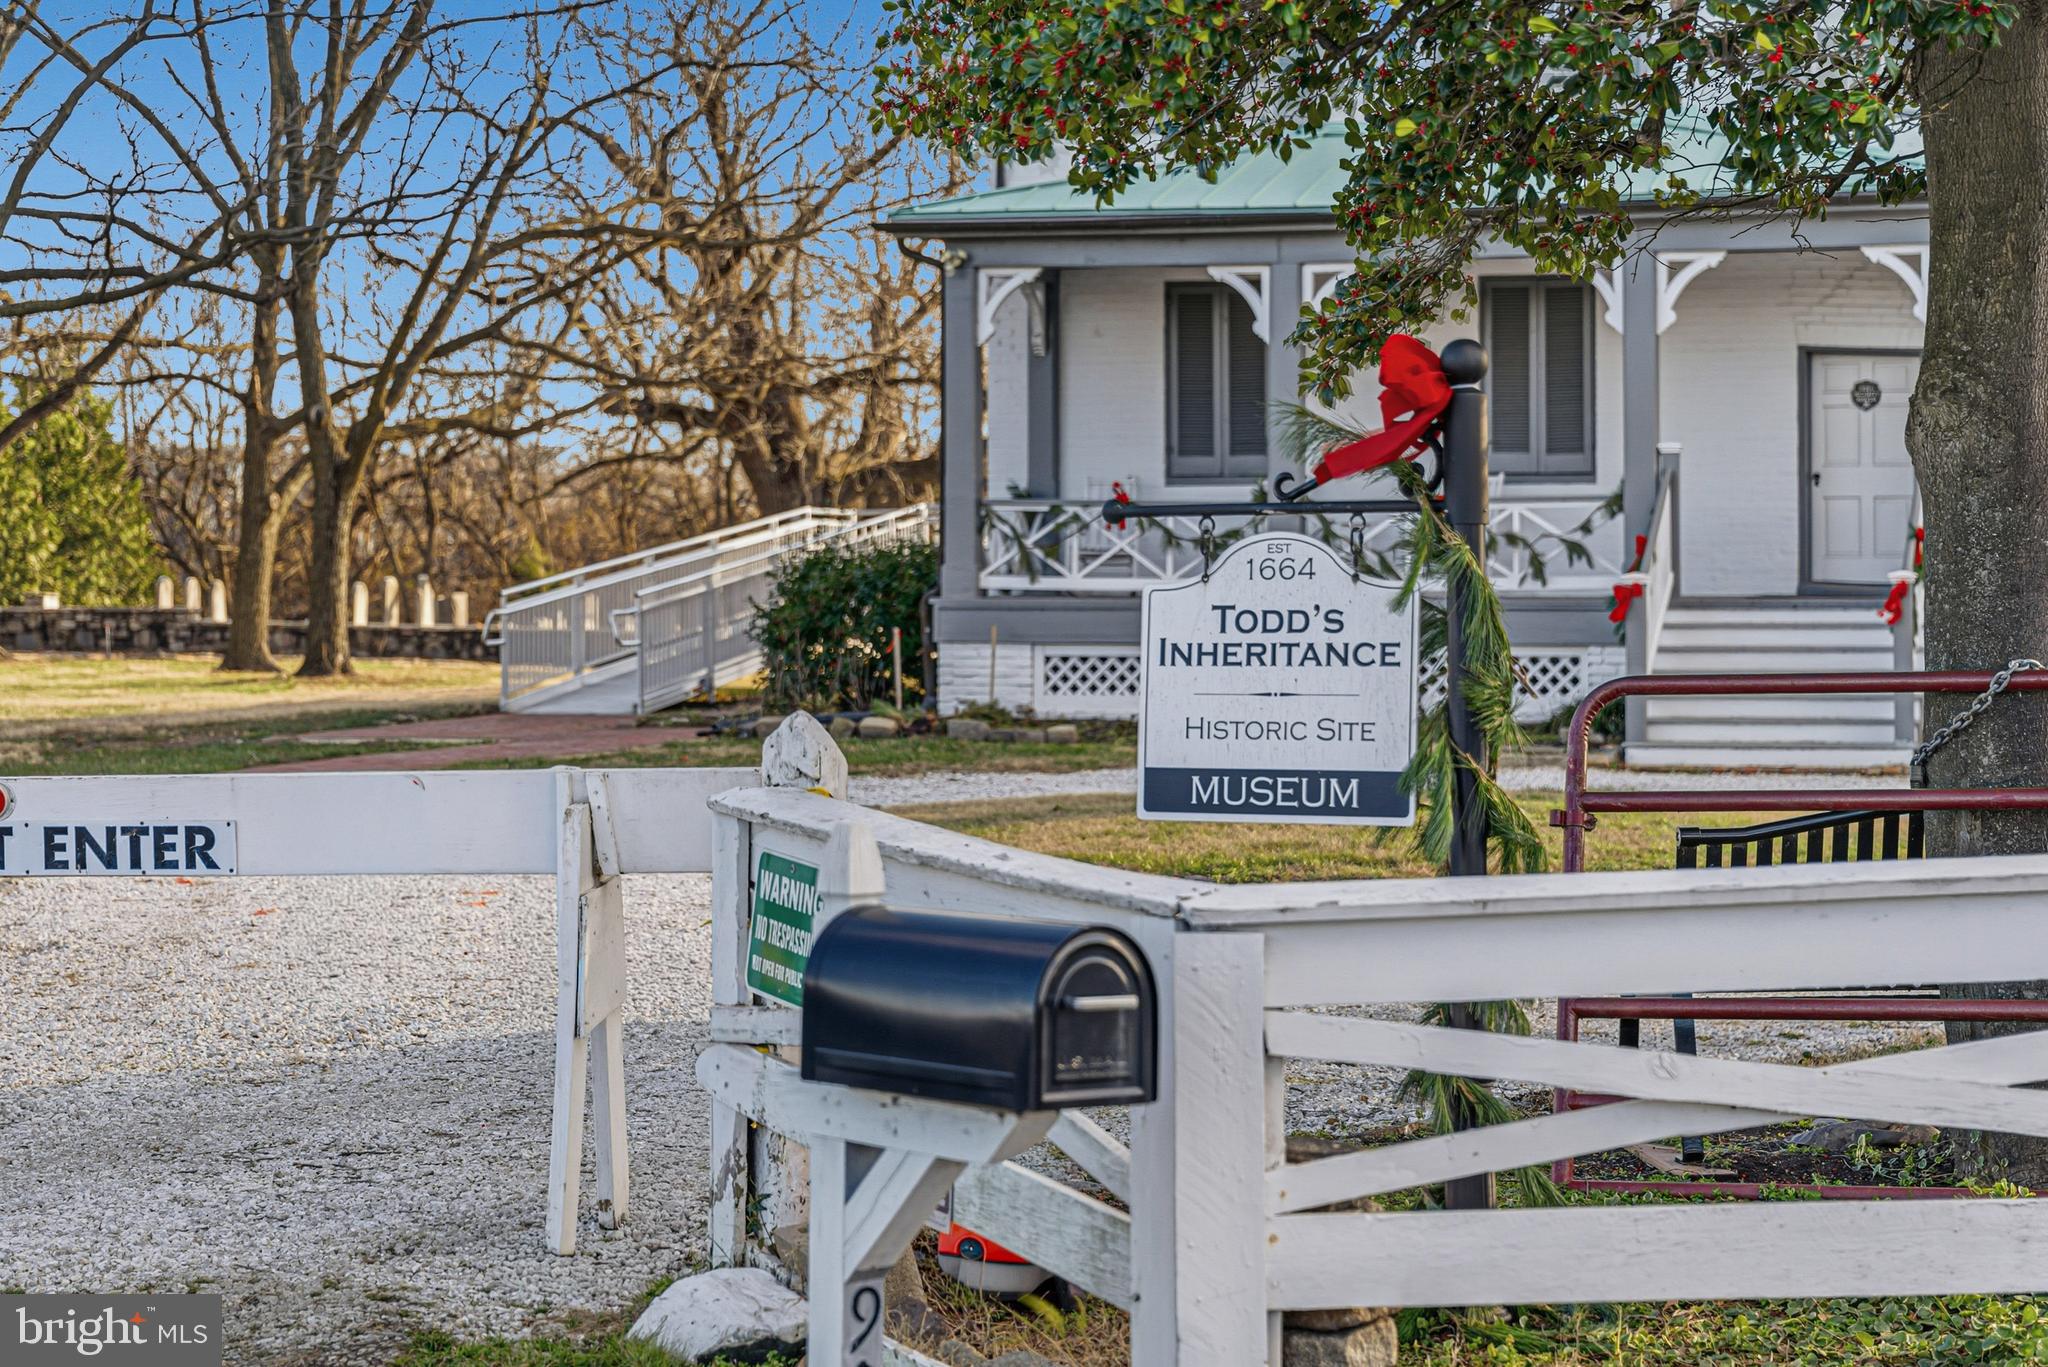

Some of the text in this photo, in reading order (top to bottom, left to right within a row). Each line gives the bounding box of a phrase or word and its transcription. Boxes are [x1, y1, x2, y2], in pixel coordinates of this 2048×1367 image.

[1266, 543, 1292, 554] EST
[1246, 557, 1316, 581] 1664
[1211, 603, 1345, 634] TODD'S
[1159, 637, 1401, 667] INHERITANCE
[1185, 716, 1376, 743] HISTORIC SITE
[1190, 775, 1360, 809] MUSEUM
[43, 825, 221, 870] ENTER
[760, 868, 824, 916] WARNING
[754, 914, 814, 958] NO TRESPASSIN
[761, 958, 775, 978] OPEN
[774, 963, 785, 982] FOR
[784, 967, 804, 988] PUBLIC
[850, 1286, 881, 1367] 9
